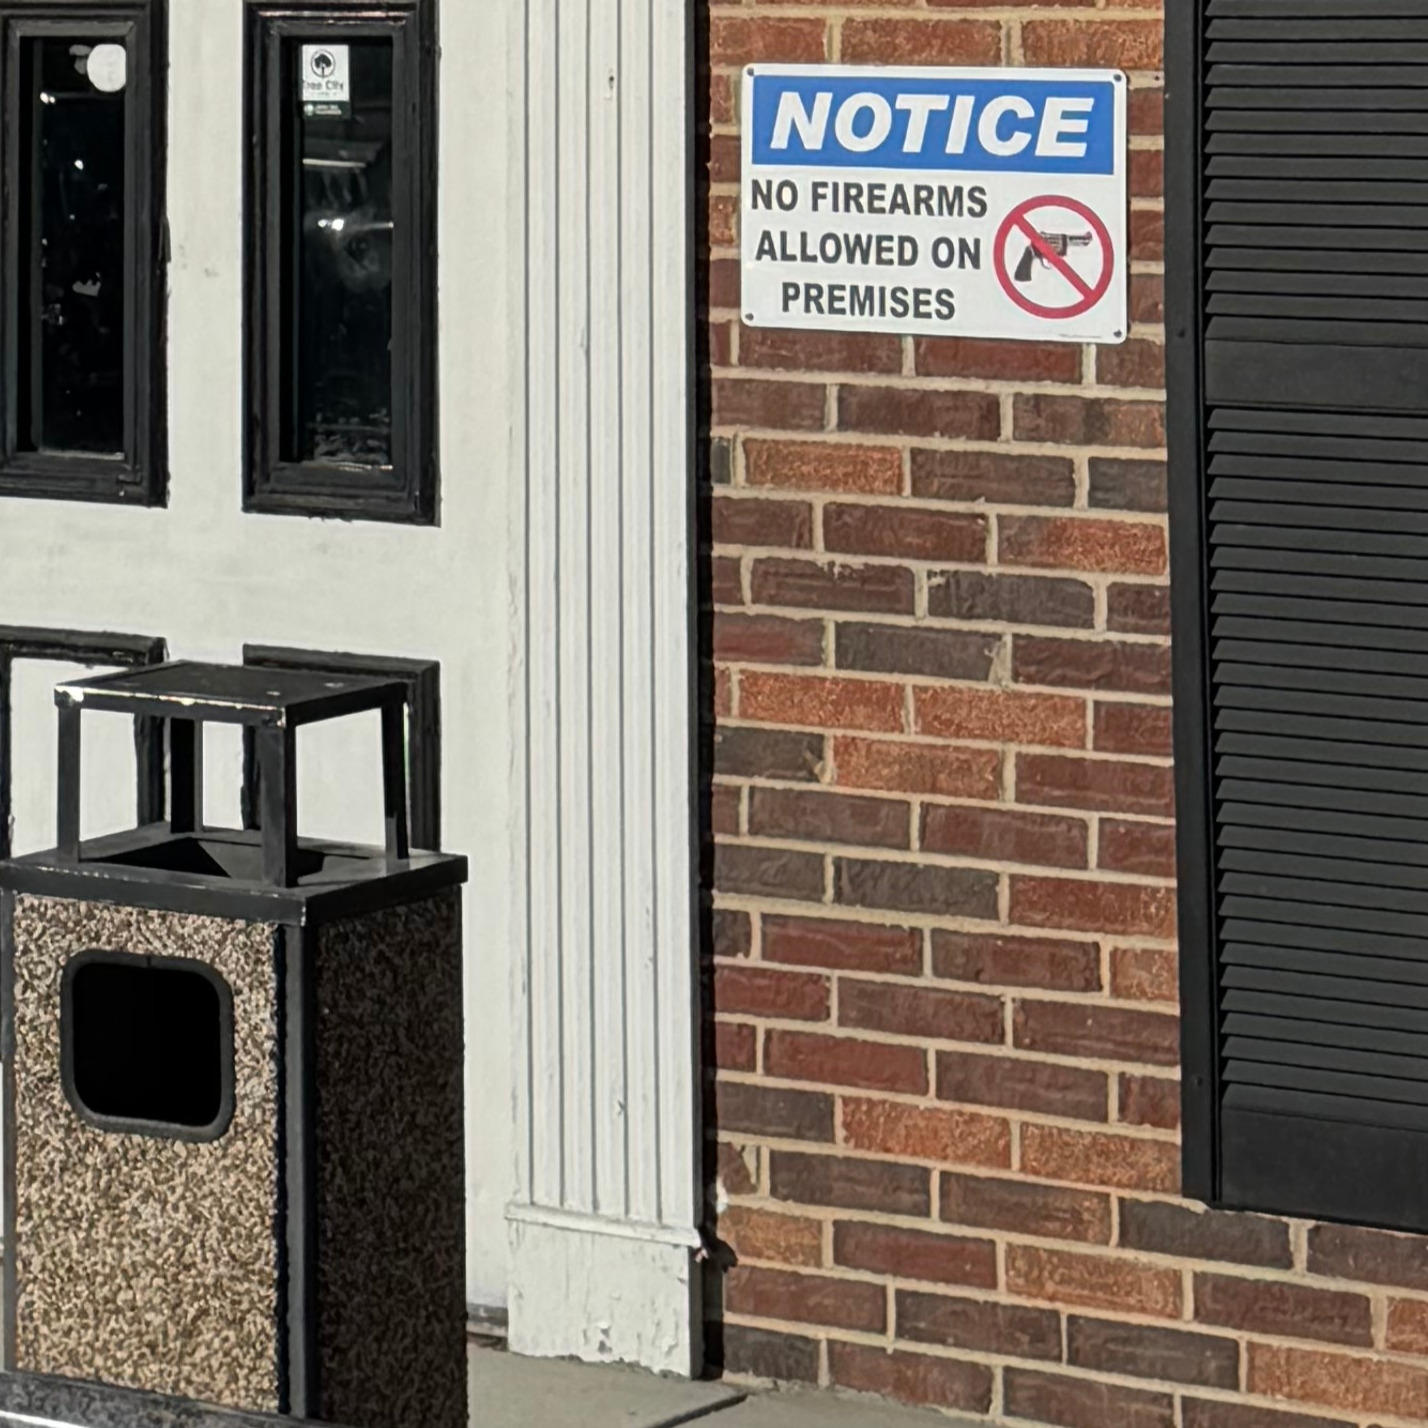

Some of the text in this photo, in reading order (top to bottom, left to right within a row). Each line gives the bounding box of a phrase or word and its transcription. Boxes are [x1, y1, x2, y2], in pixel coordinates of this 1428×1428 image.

[769, 90, 1095, 158] NOTICE
[750, 178, 988, 218] NO FIREARMS
[755, 230, 982, 271] ALLOWED ON
[781, 281, 956, 321] PREMISES
